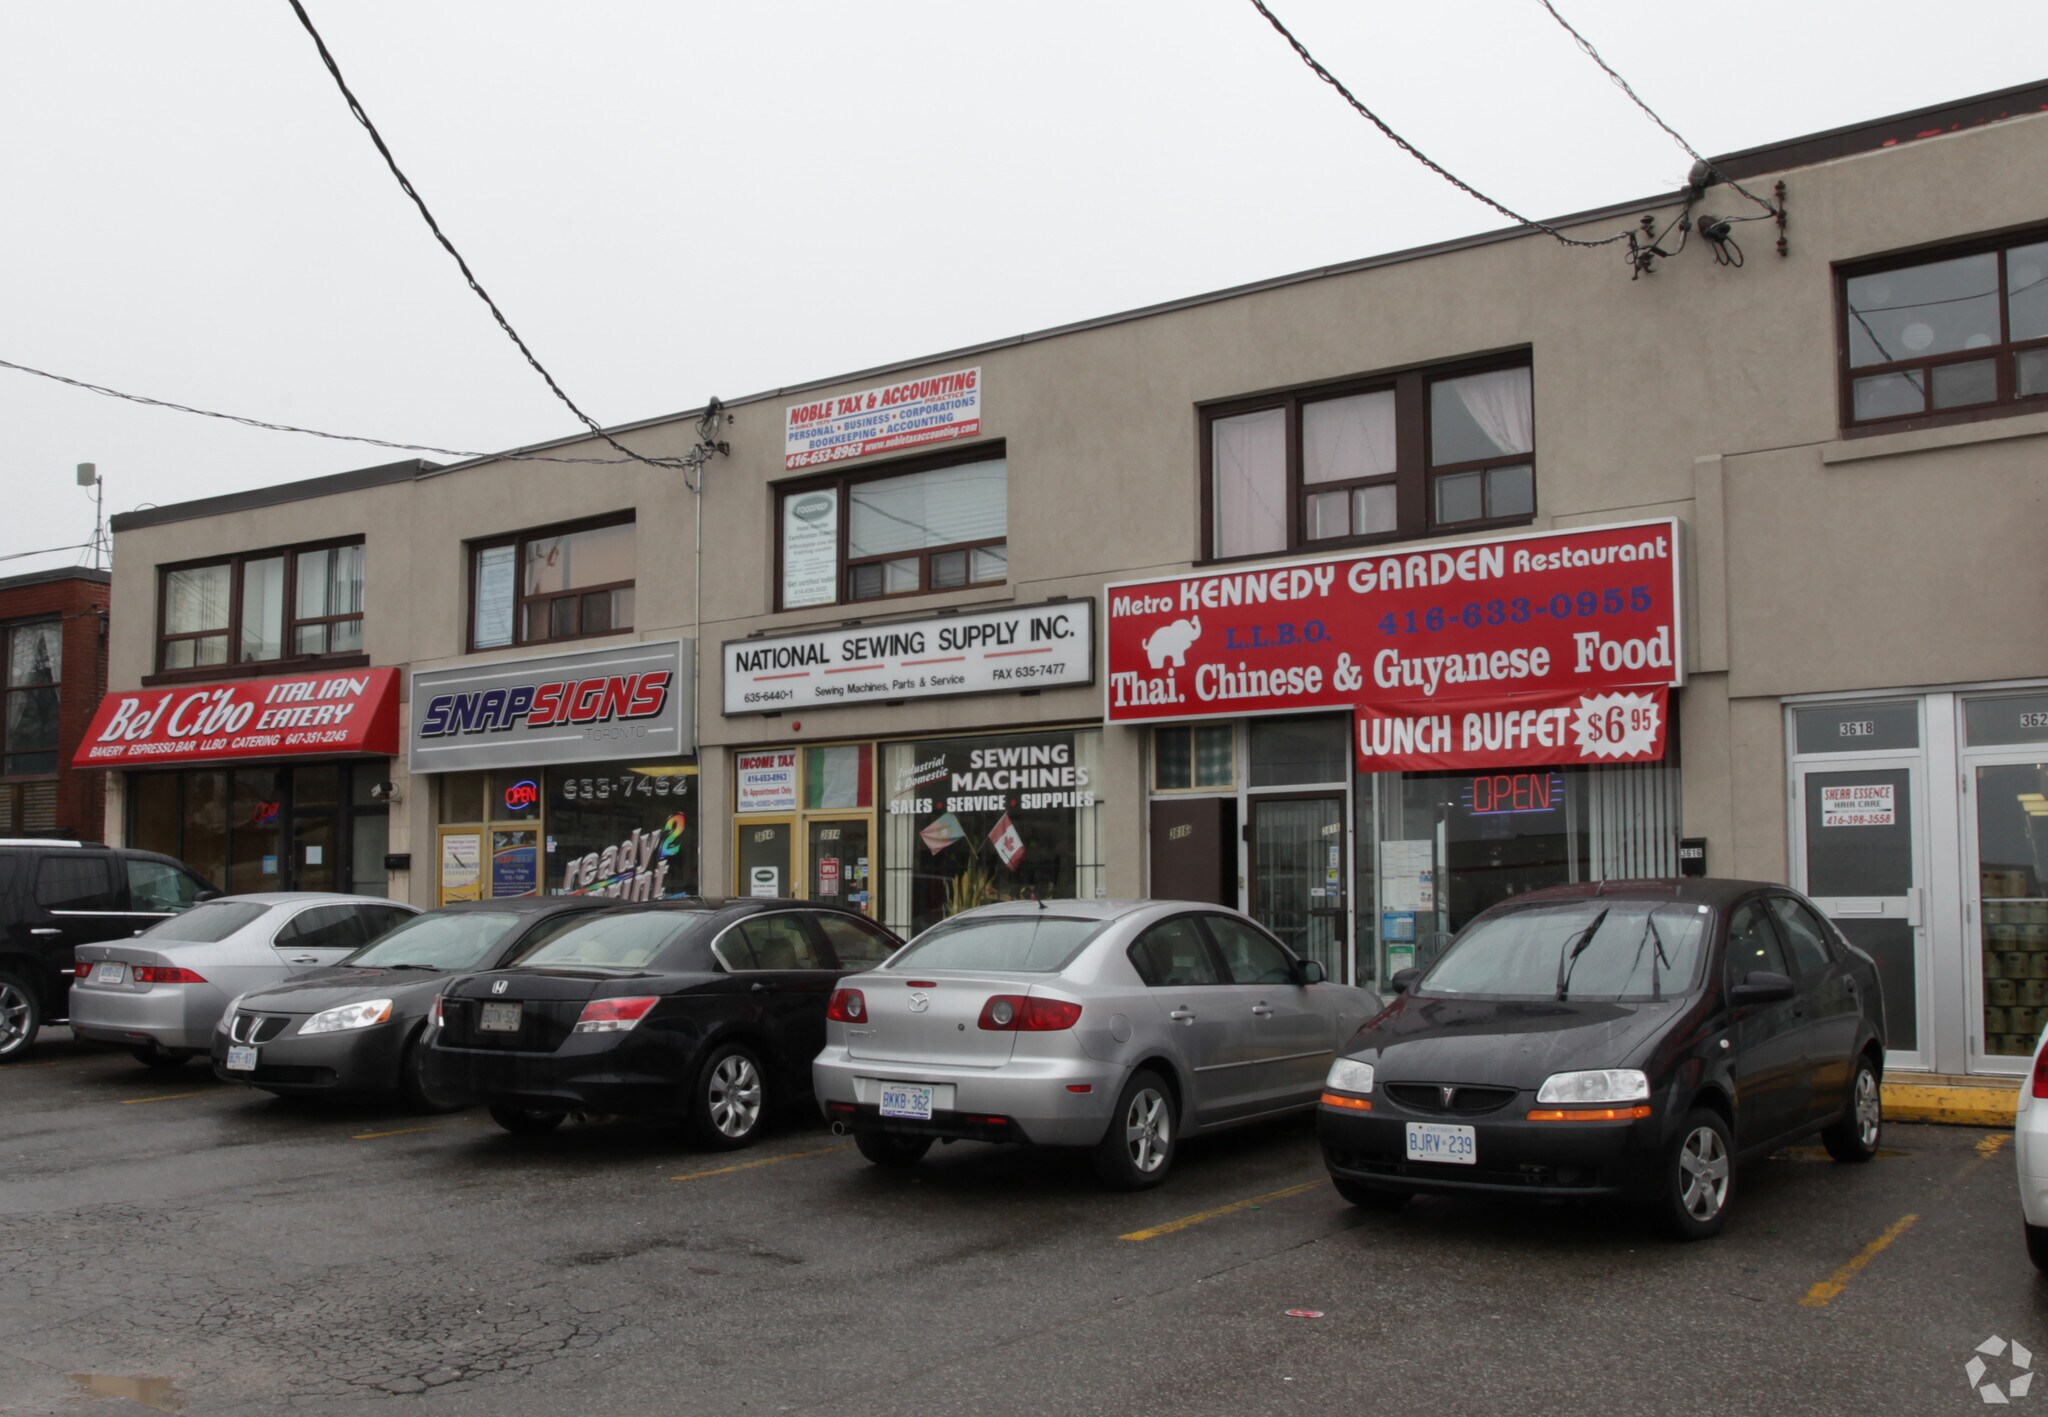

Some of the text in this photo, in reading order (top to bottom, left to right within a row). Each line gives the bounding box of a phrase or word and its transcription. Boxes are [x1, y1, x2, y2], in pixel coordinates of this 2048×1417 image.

[790, 372, 977, 425] NOBLE TAX & ACCOUNTING
[924, 391, 966, 405] PRACTICE
[788, 397, 976, 442] PERSONAL BUSINESS CORPORATIONS
[809, 413, 954, 449] BOOKKEEPING ACCOUNTING
[786, 421, 978, 469] 416-653-8963 www.nobletaxaccounting.com
[1112, 536, 1667, 619] Metro KENNEDY GARDEN Restaurant
[1225, 586, 1652, 651] L.L.B.O. 416-633-0955
[736, 615, 1075, 673] NATIONAL SEWING SUPPLY INC.
[993, 663, 1066, 681] FAX 635-7477
[1111, 626, 1672, 707] Thai. Chinese & Guyanese Food
[744, 674, 965, 703] 635-6440-1 Sewing Machines, Parts & Service
[98, 676, 370, 743] Bel Cibo ITALIAN
[256, 703, 354, 731] EATERY
[585, 725, 646, 742] TORONTO
[1359, 714, 1452, 757] LUNCH
[1462, 707, 1570, 752] BUFFET
[1841, 721, 1873, 736] 3618
[89, 730, 348, 758] BAKERY ESPRESSO BAR LLBO CATERING 647-351-2245
[740, 754, 796, 770] INCOME TAX
[898, 754, 946, 779] Industrial
[970, 744, 1069, 770] SEWING
[563, 775, 688, 799] 633-7462
[747, 772, 788, 783] 416-653-8963
[904, 767, 949, 790] Domestic
[951, 767, 1089, 792] MACHINES
[505, 786, 537, 804] OPEN
[743, 786, 792, 798] By Appointment Only
[890, 791, 1095, 814] SALES SERVICE SUPPLIES
[1472, 774, 1551, 812] OPEN
[1825, 786, 1891, 801] SHEAR ESSENCE
[1834, 800, 1881, 809] HAIR CARE
[1826, 814, 1892, 825] 416-398-3558
[563, 811, 687, 891] ready 2
[1680, 848, 1703, 859] 3616
[822, 865, 836, 874] OPEN
